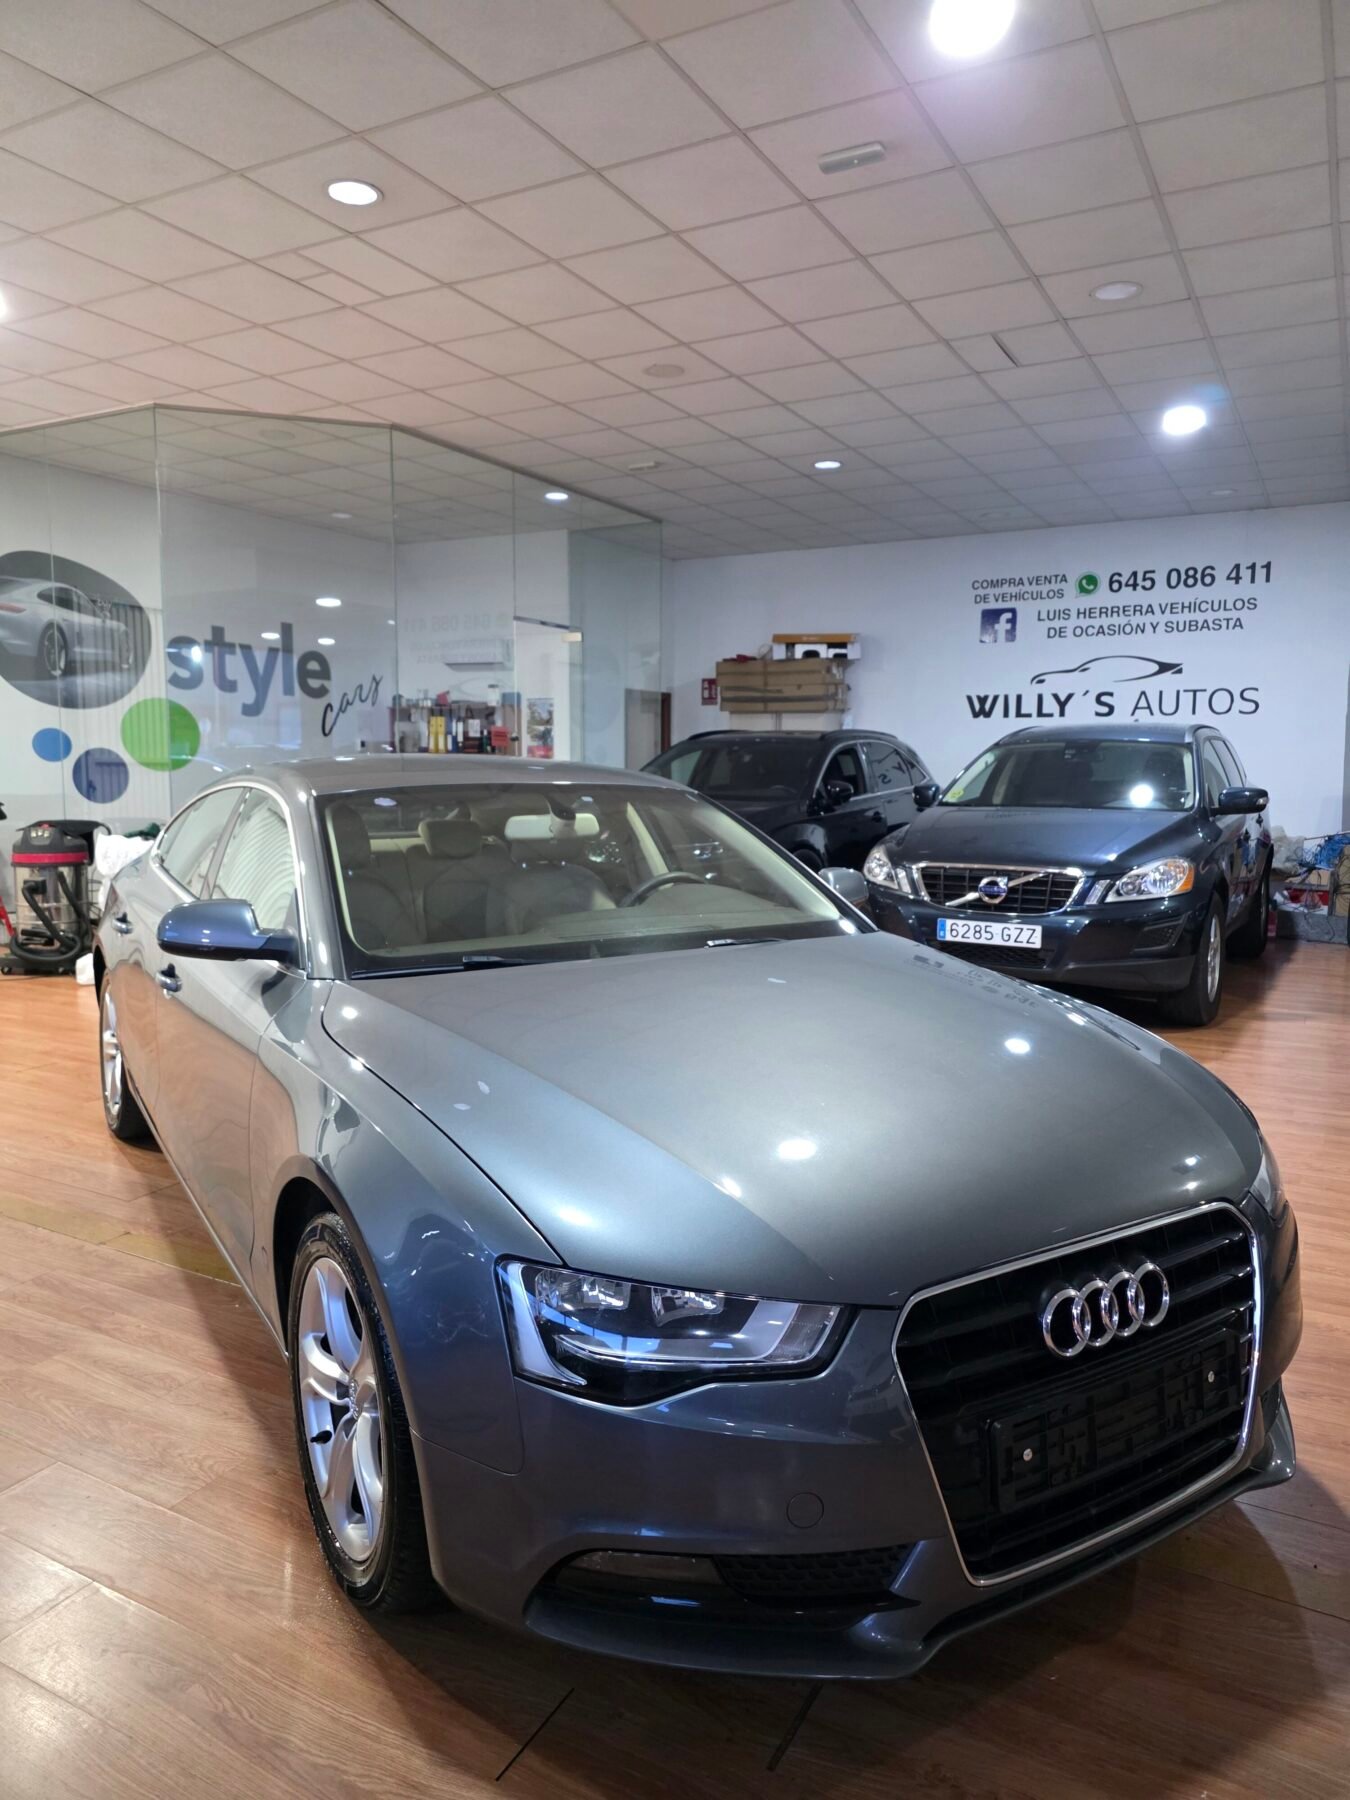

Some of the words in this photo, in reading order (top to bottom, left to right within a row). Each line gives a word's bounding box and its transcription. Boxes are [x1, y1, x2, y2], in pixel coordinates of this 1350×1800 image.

[1108, 570, 1156, 593] 645
[1166, 565, 1216, 590] 086
[1226, 560, 1272, 585] 411
[974, 593, 991, 604] DE
[993, 588, 1065, 603] VEHÍCULOS
[1037, 608, 1071, 622] LUIS
[1076, 604, 1155, 620] HERRERA
[1159, 597, 1258, 615] VEHÍCULOS
[1047, 626, 1068, 639] DE
[1072, 620, 1146, 638] OCASIÓN
[1150, 621, 1160, 634] Y
[1164, 617, 1244, 634] SUBASTA
[166, 622, 331, 717] style
[320, 673, 384, 738] cars
[1130, 687, 1260, 716] AUTOS
[950, 922, 994, 941] 6285
[1001, 926, 1037, 945] GZZ
